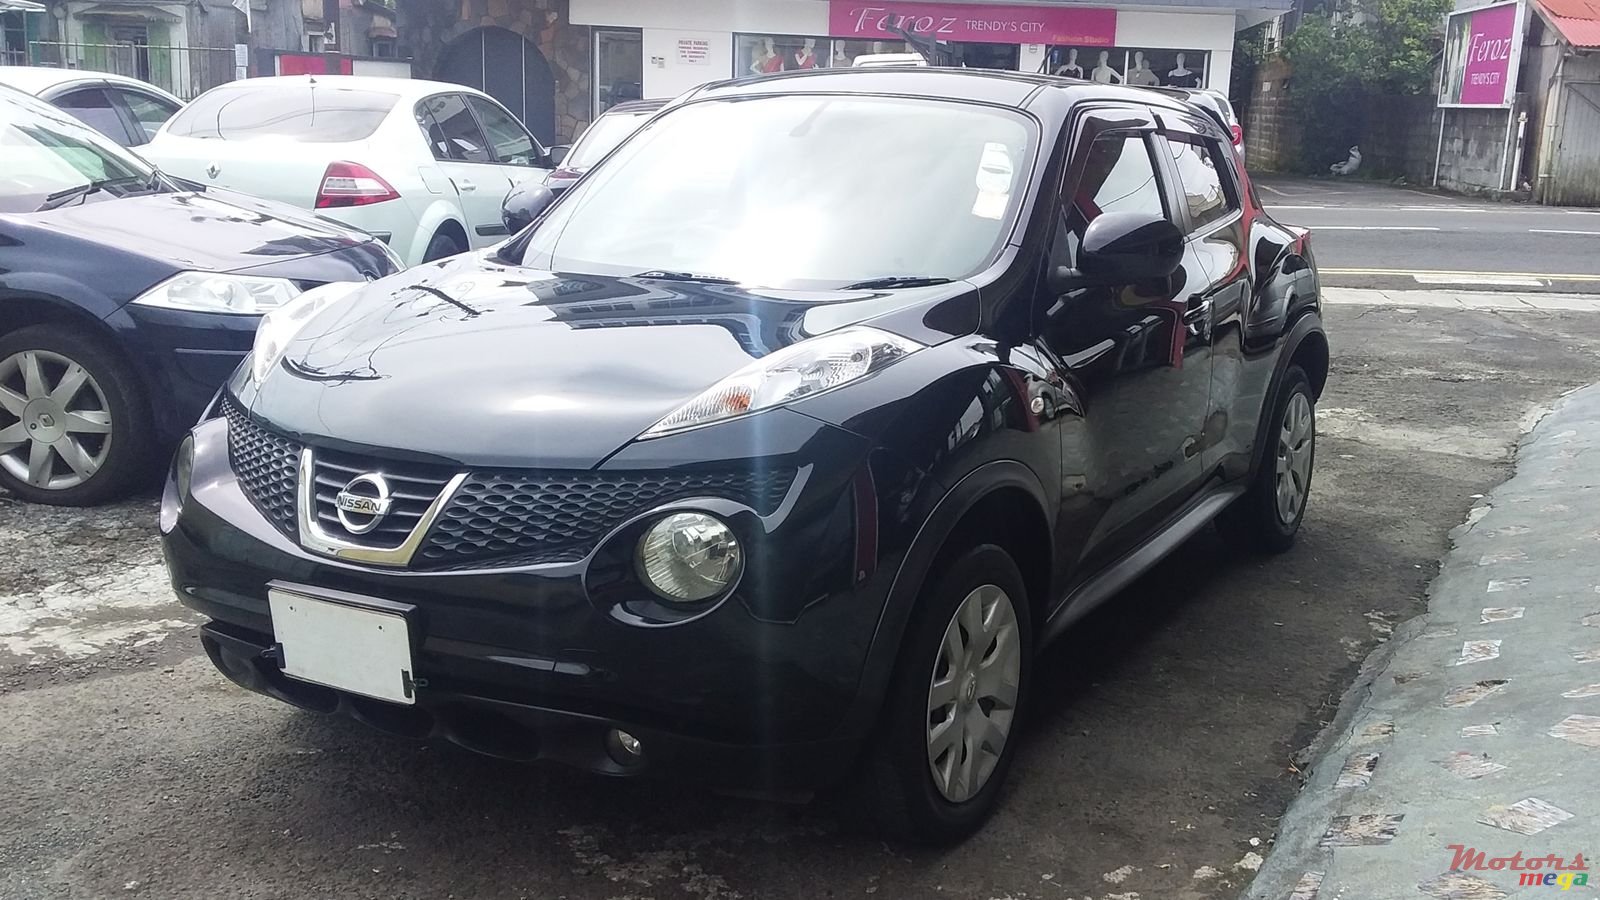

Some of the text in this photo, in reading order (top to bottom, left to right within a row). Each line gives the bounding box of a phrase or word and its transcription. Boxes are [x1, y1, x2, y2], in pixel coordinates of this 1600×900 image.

[965, 20, 1018, 32] TRENDY'S
[1020, 21, 1046, 33] CITY
[1052, 34, 1110, 44] Fashion Studio
[1467, 33, 1512, 66] Feroz
[338, 496, 381, 511] NISSAN
